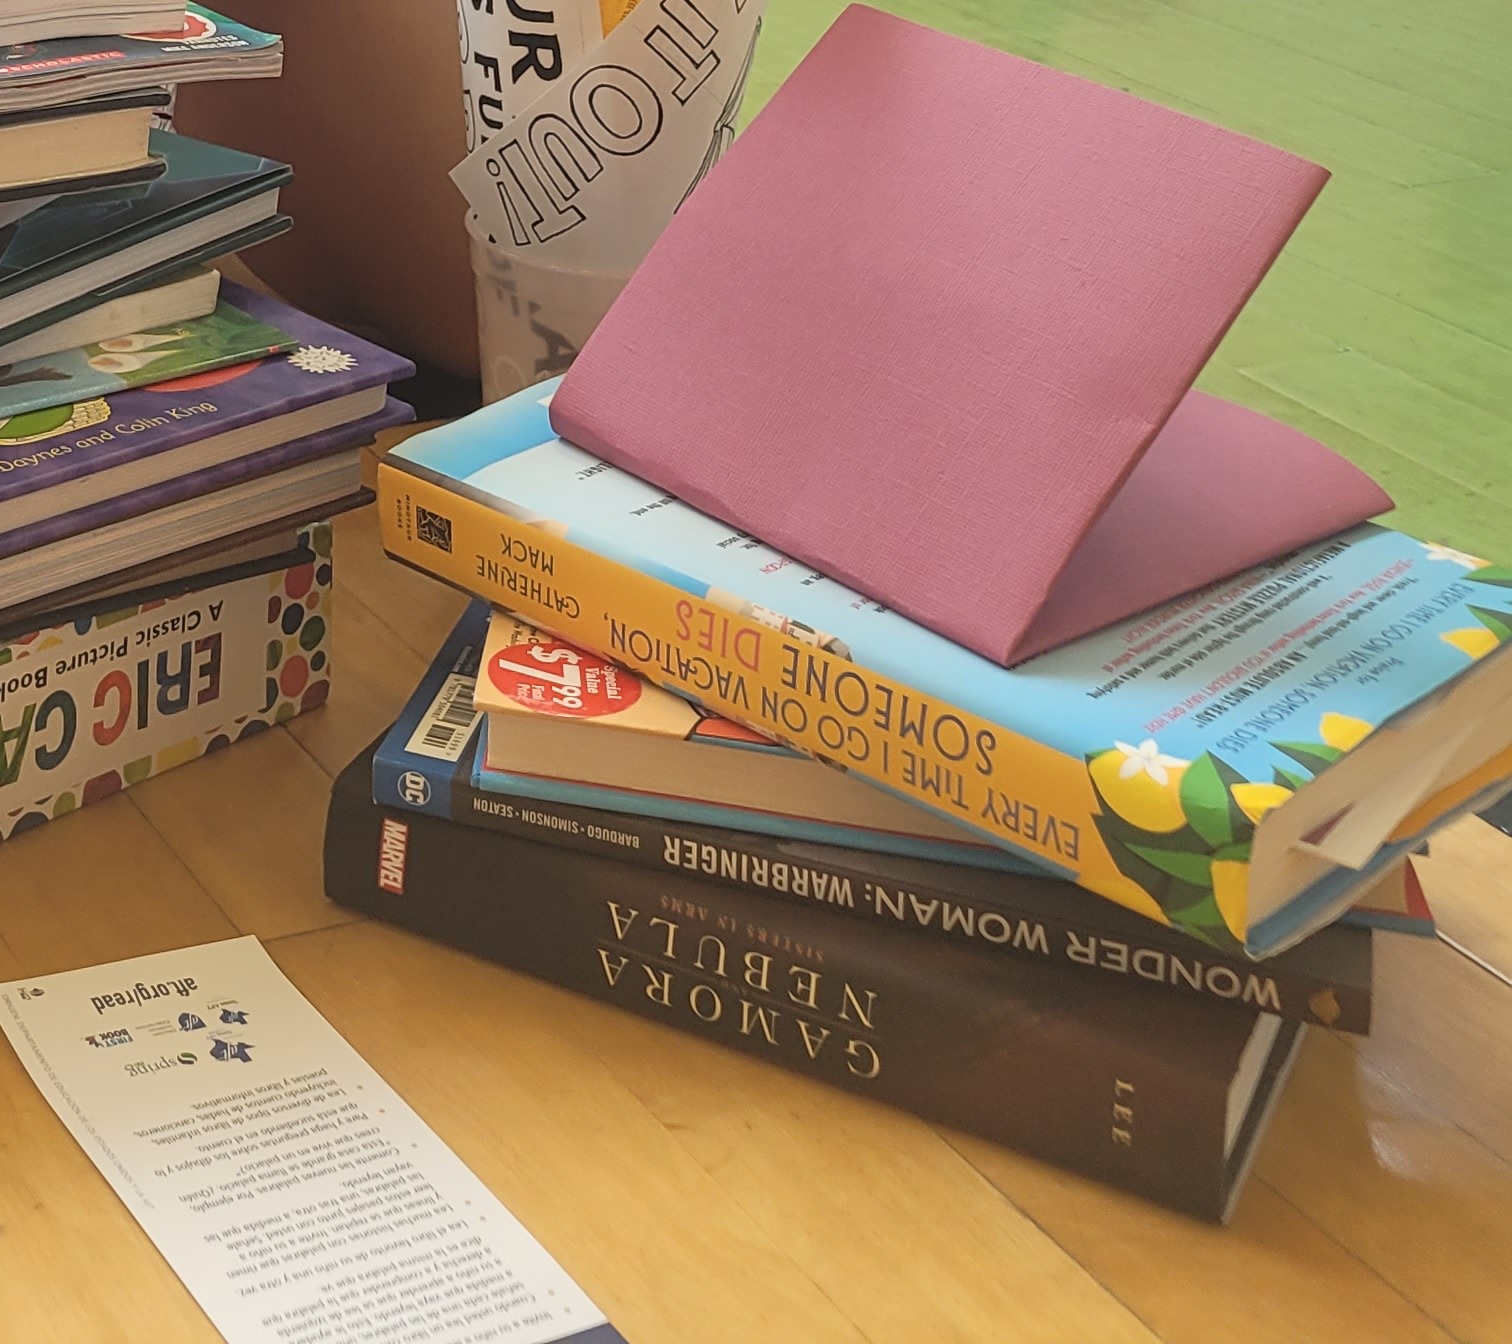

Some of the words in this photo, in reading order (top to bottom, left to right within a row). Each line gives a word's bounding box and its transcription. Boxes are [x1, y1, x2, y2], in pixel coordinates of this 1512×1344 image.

[6, 50, 125, 72] SCHOLASTIC
[485, 63, 663, 248] OUT!
[75, 429, 114, 457] and
[115, 411, 169, 443] Colin
[168, 398, 218, 430] King
[500, 532, 555, 576] MACK
[475, 554, 582, 620] CATHERINE
[134, 609, 203, 650] Classic
[207, 599, 225, 623] A
[675, 599, 762, 672] DIES
[54, 635, 130, 678] Picture
[603, 613, 750, 711] VACATION,
[92, 632, 224, 746] ERIC
[585, 667, 601, 695] Value
[603, 664, 623, 700] Special
[759, 685, 809, 734] ON
[782, 643, 997, 777] SOMEONE
[815, 716, 871, 763] GO
[880, 736, 890, 775] I
[401, 771, 426, 804] DC
[902, 750, 967, 810] TIME
[472, 797, 514, 818] SEATON
[520, 809, 579, 835] SIMONSON
[981, 788, 1080, 862] EVERY
[586, 824, 641, 848] BARDUGO
[380, 818, 408, 894] MARVEL
[661, 833, 856, 908] WARBRINGER
[660, 893, 710, 921] ARMS
[864, 884, 1051, 956] WOMAN:
[604, 898, 879, 1030] NEBULA
[1064, 926, 1282, 1013] WONDER
[89, 976, 199, 1015] aft.org/read
[594, 946, 884, 1082] GAMORA
[99, 1028, 129, 1041] BOOK
[104, 1033, 134, 1049] FIRST
[124, 1055, 178, 1078] spring
[190, 1088, 253, 1111] informativos.
[246, 1093, 285, 1111] cuentos
[255, 1082, 284, 1097] libros
[272, 1097, 313, 1115] diversos
[285, 1078, 338, 1100] incluyendo
[1111, 1077, 1136, 1148] LEE
[150, 1128, 201, 1147] infantiles,
[231, 1141, 259, 1156] sobre
[260, 1128, 311, 1148] preguntas
[175, 1154, 214, 1174] dibujos
